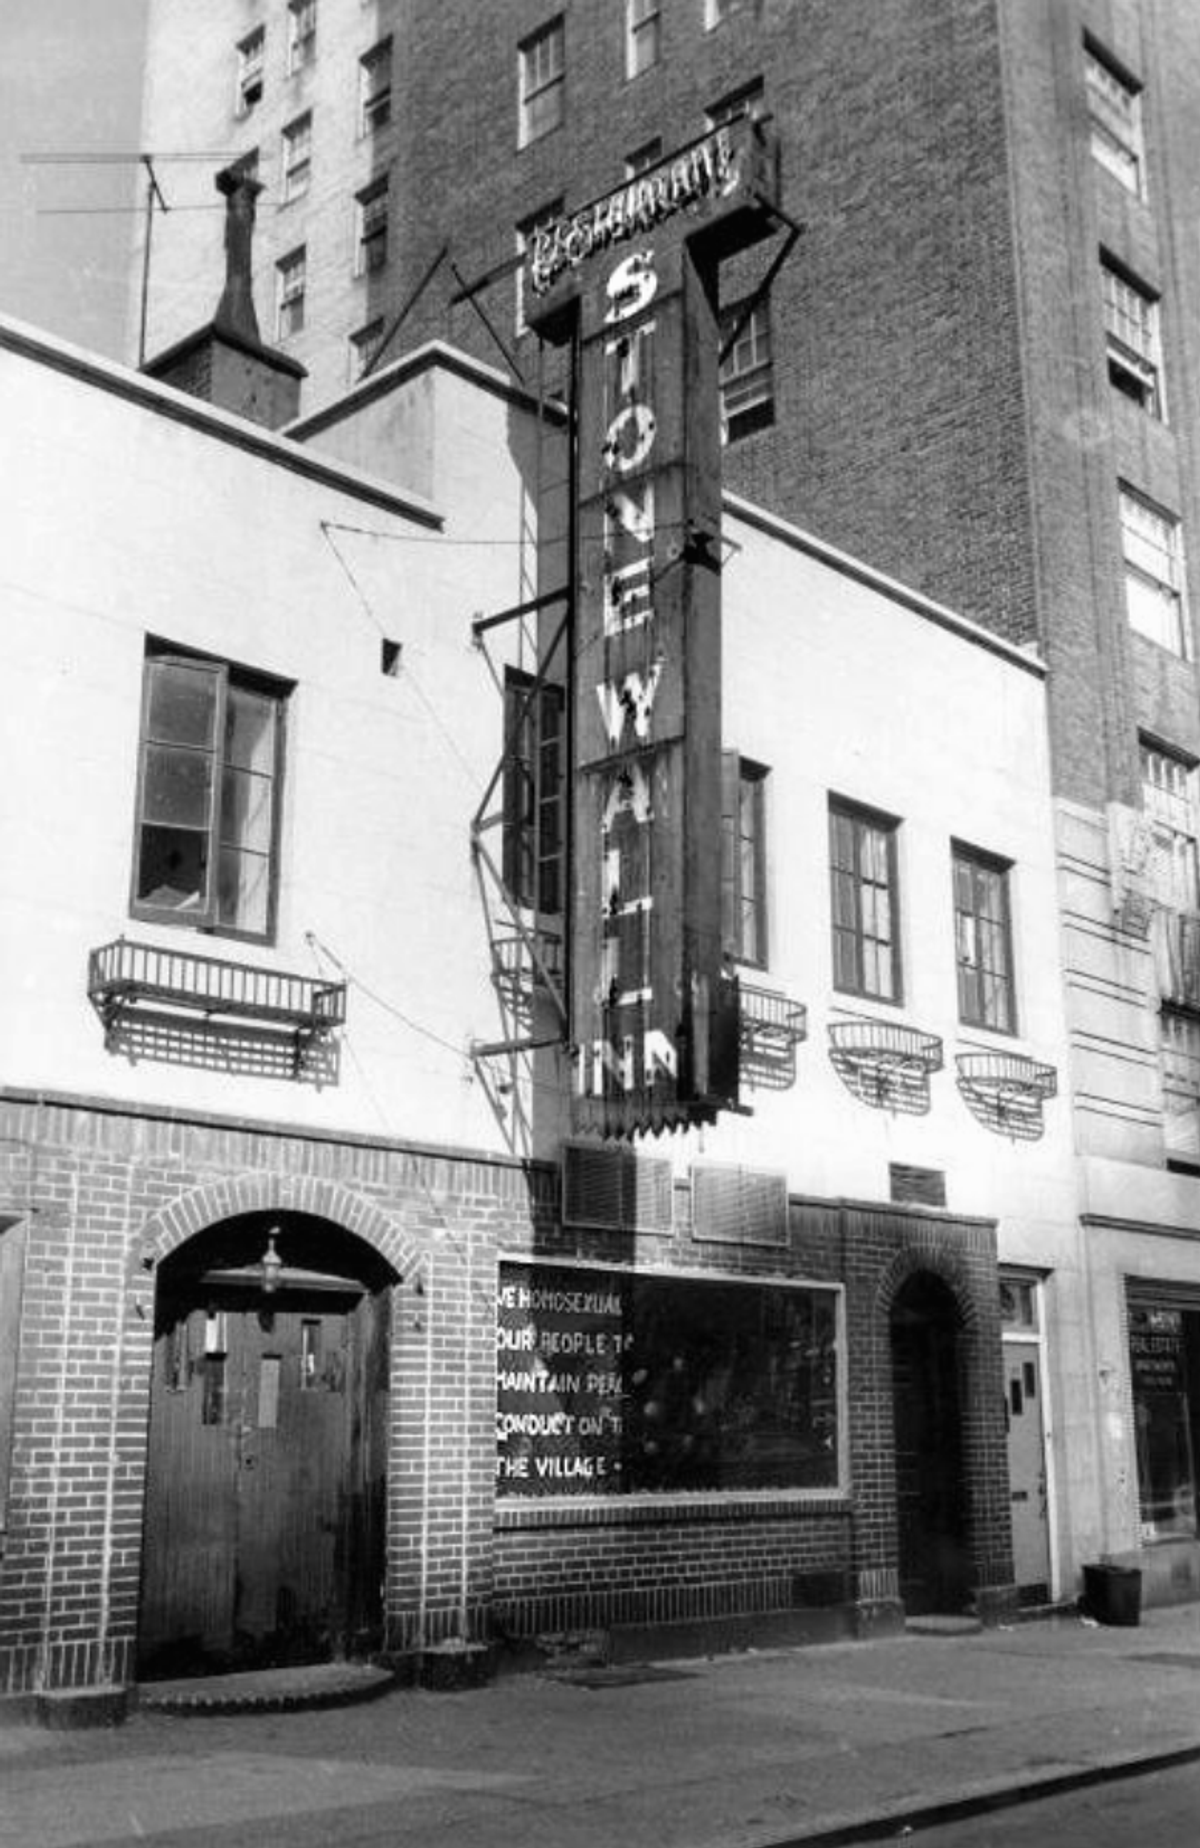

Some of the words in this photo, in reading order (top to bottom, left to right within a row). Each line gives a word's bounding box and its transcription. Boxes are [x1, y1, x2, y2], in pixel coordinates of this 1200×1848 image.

[596, 249, 665, 1007] STONEWALL
[578, 1030, 678, 1096] INN
[496, 1328, 534, 1352] OUR
[541, 1331, 606, 1355] PEOPLE
[495, 1412, 575, 1440] CONDUCT
[579, 1414, 603, 1435] ON
[496, 1456, 529, 1477] THE
[535, 1456, 606, 1478] VILLAGE
